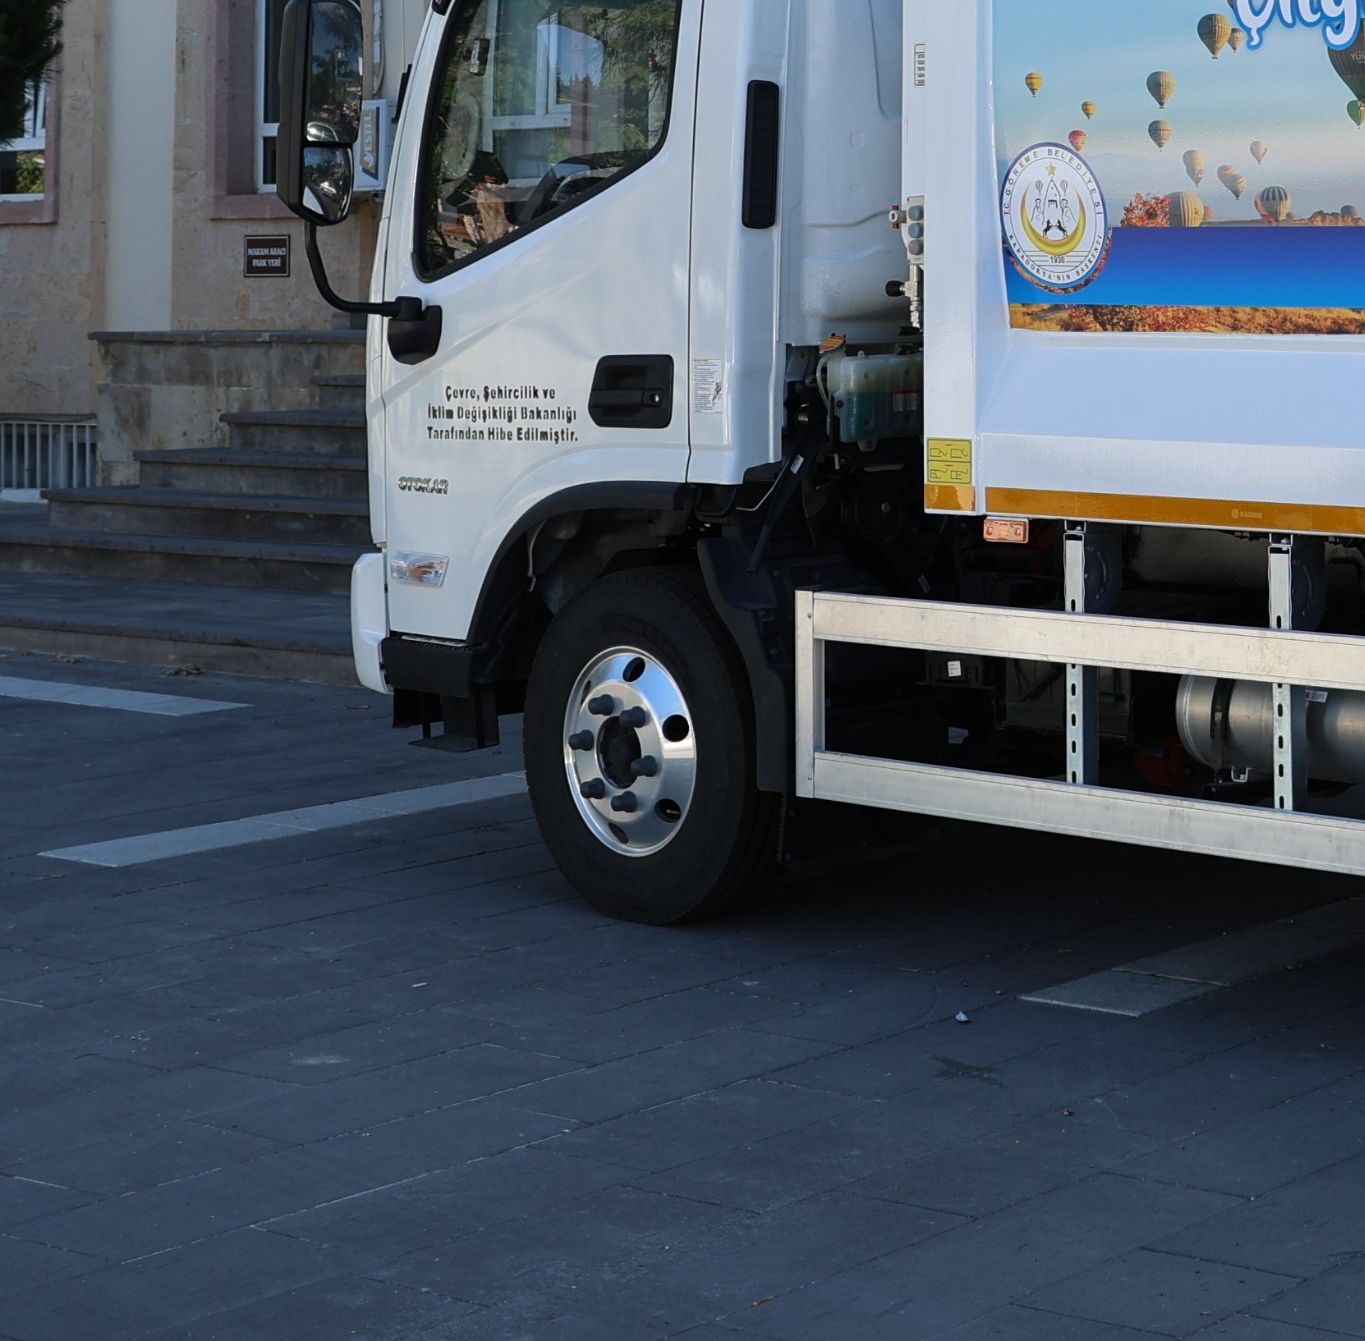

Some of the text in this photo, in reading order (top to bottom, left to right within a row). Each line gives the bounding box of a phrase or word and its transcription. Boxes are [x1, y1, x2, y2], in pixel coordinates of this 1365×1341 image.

[445, 385, 556, 402] Çevre, Şehircilik ve
[428, 403, 577, 424] İklim Değişikliği Bakanlığı
[427, 426, 578, 444] Tarafından Hibe Edilmiştir.
[398, 476, 449, 495] OTOKAR
